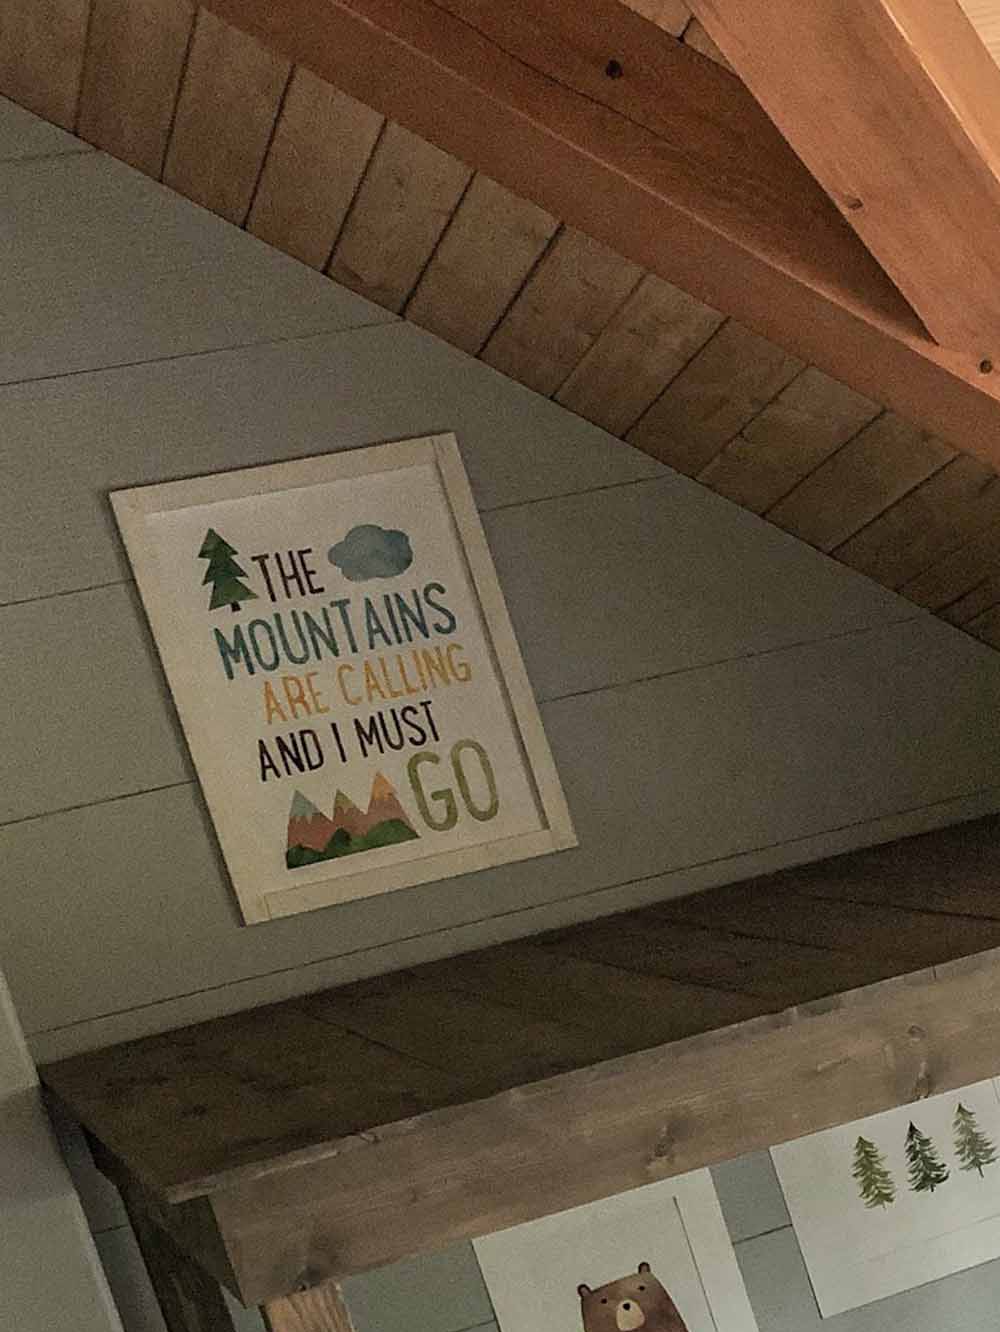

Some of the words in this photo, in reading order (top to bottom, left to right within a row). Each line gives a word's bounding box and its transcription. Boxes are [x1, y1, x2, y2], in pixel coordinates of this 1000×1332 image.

[251, 548, 325, 602] THE
[214, 583, 457, 681] MOUNTAINS
[262, 671, 331, 725] ARE
[337, 643, 472, 706] CALLING
[257, 729, 325, 782] AND
[332, 723, 347, 763] I
[357, 700, 441, 759] MUST
[407, 739, 499, 832] GO
